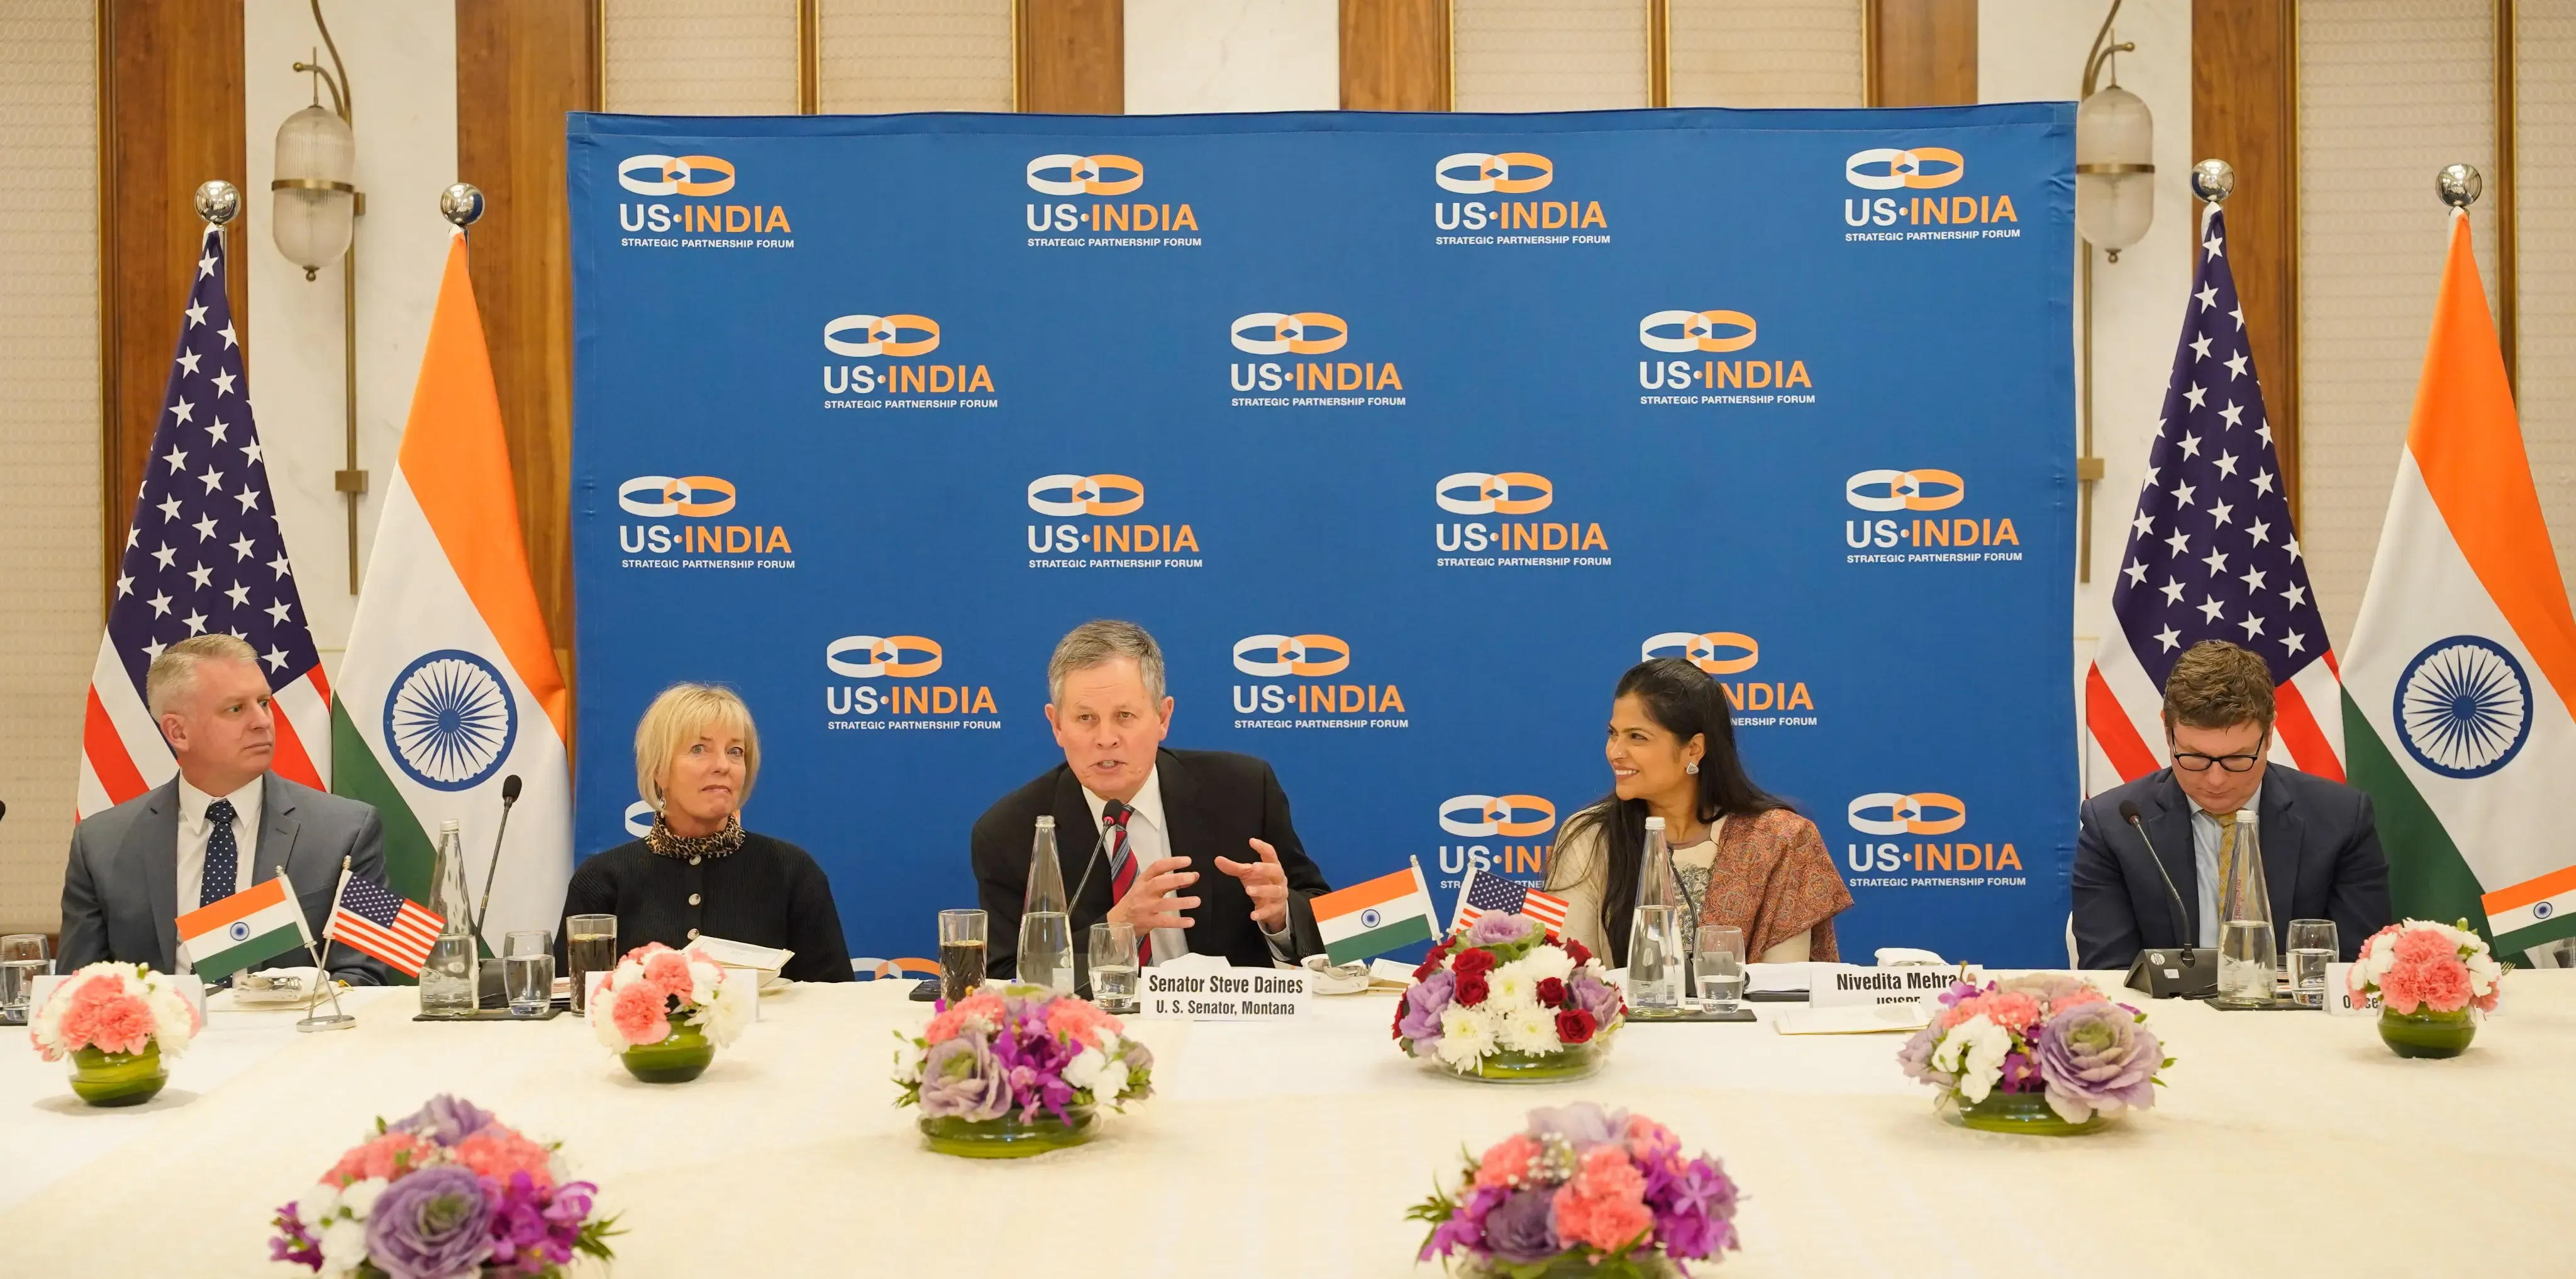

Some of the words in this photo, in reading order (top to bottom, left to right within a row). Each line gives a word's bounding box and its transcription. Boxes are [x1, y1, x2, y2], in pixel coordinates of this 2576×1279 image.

[1436, 236, 1494, 245] STRATEGIC
[1497, 236, 1570, 245] PARTNERSHIP
[1572, 235, 1611, 244] FORUM
[1845, 232, 1904, 242] STRATEGIC
[1906, 230, 1980, 240] PARTNERSHIP
[1982, 229, 2021, 238] FORUM
[621, 238, 679, 248] STRATEGIC
[681, 239, 754, 248] PARTNERSHIP
[757, 240, 794, 248] FORUM
[1027, 238, 1085, 247] STRATEGIC
[1088, 238, 1161, 246] PARTNERSHIP
[1163, 238, 1202, 246] FORUM
[824, 400, 882, 409] STRATEGIC
[885, 399, 957, 408] PARTNERSHIP
[960, 399, 998, 408] FORUM
[1231, 397, 1290, 407] STRATEGIC
[1292, 397, 1365, 406] PARTNERSHIP
[1367, 397, 1406, 406] FORUM
[1640, 396, 1699, 404] STRATEGIC
[1701, 395, 1775, 404] PARTNERSHIP
[1777, 395, 1816, 404] FORUM
[1436, 558, 1495, 567] STRATEGIC
[1497, 557, 1571, 567] PARTNERSHIP
[1573, 557, 1611, 566] FORUM
[1846, 554, 1906, 563] STRATEGIC
[1908, 553, 1982, 562] PARTNERSHIP
[1984, 552, 2023, 562] FORUM
[622, 559, 679, 568] STRATEGIC
[682, 560, 755, 568] PARTNERSHIP
[757, 560, 795, 568] FORUM
[1028, 559, 1087, 568] STRATEGIC
[1089, 559, 1162, 568] PARTNERSHIP
[1164, 559, 1202, 568] FORUM
[828, 721, 886, 730] STRATEGIC
[888, 721, 960, 729] PARTNERSHIP
[963, 721, 1001, 729] FORUM
[1235, 719, 1292, 729] STRATEGIC
[1295, 719, 1368, 728] PARTNERSHIP
[1370, 719, 1409, 728] FORUM
[1779, 717, 1817, 726] FORUM
[1849, 878, 1908, 887] STRATEGIC
[1911, 877, 1985, 886] PARTNERSHIP
[1987, 877, 2026, 886] FORUM
[1149, 975, 1205, 992] Senator
[1210, 975, 1249, 993] Steve
[1254, 976, 1303, 994] Daines
[1836, 973, 1902, 990] Nivedita
[1907, 972, 1957, 989] Mehra
[1157, 1000, 1168, 1014] U.
[1172, 1000, 1184, 1014] S.
[1188, 1000, 1237, 1016] Senator,
[1241, 1001, 1294, 1015] Montana
